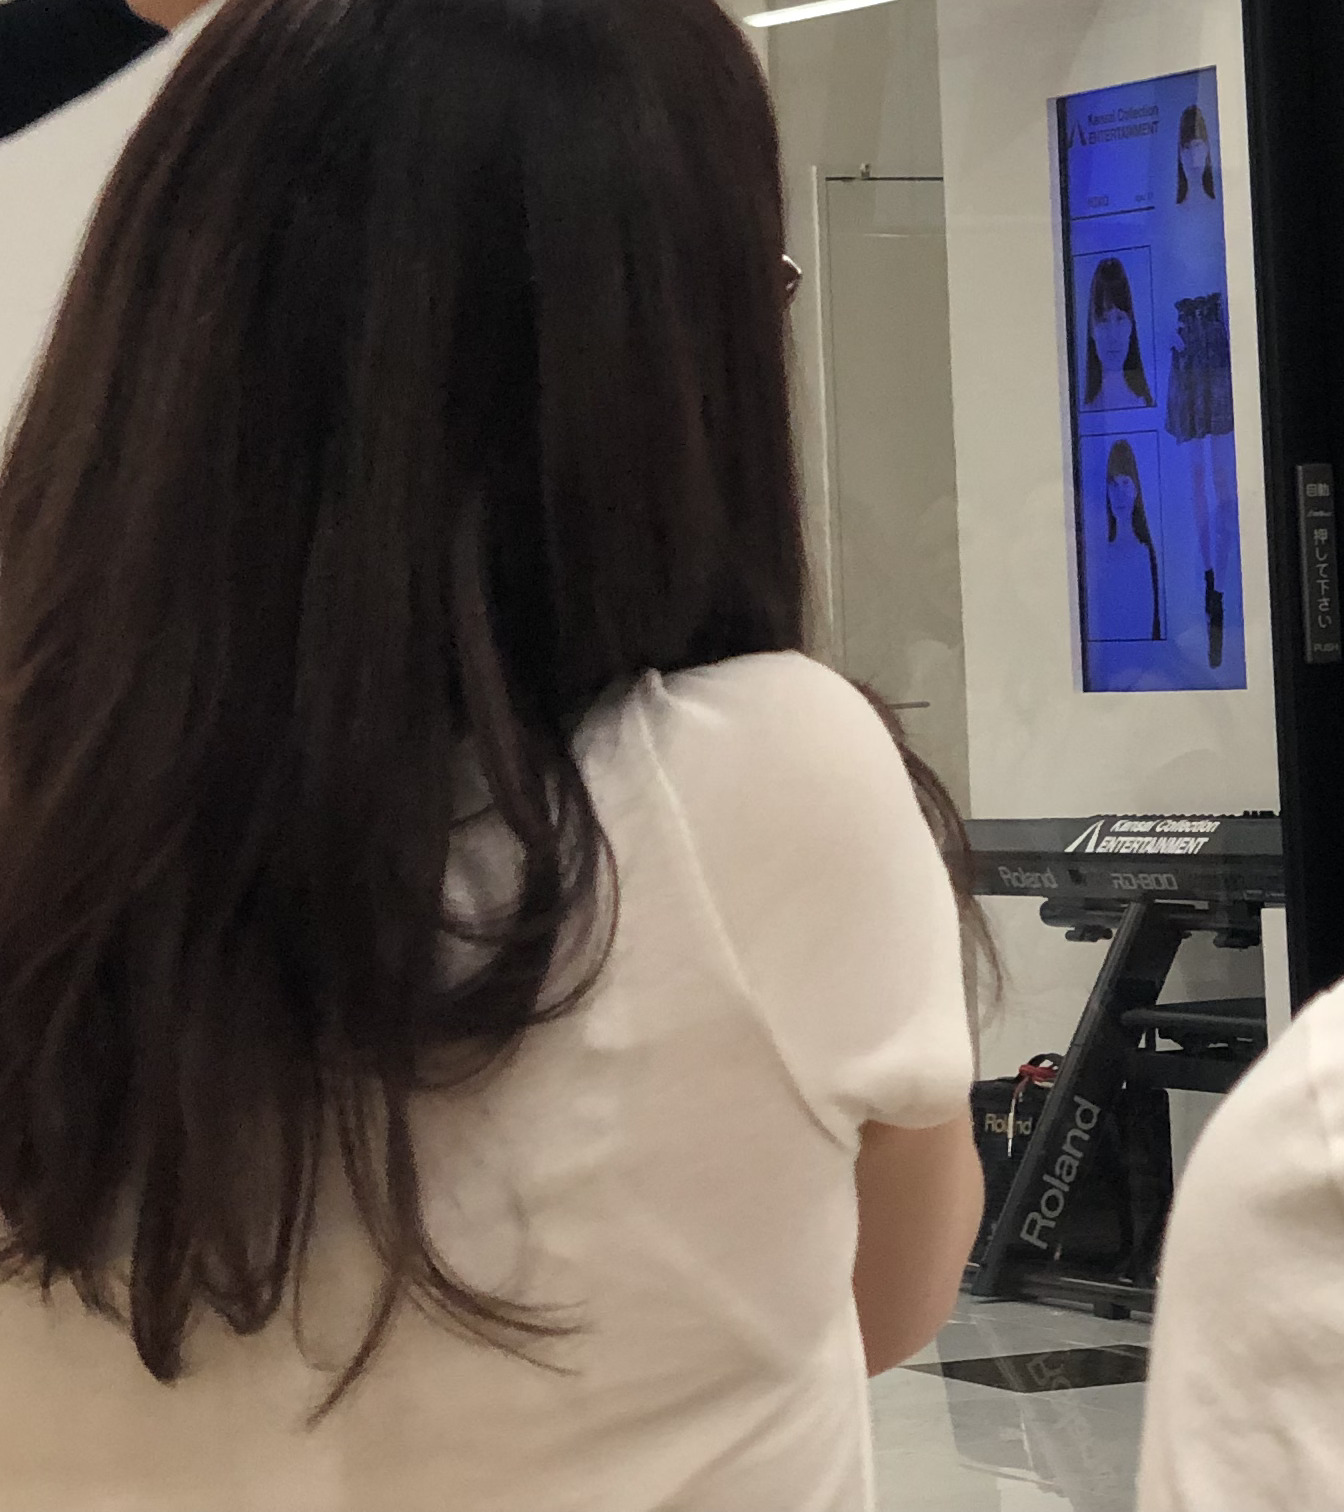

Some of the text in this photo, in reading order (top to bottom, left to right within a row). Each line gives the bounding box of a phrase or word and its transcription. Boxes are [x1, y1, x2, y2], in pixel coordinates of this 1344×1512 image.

[1312, 528, 1333, 629] 押して下さい
[1313, 642, 1339, 653] PUSH
[1109, 819, 1221, 833] Kansai Collection
[1096, 836, 1209, 855] ENTERTAINMENT
[997, 866, 1059, 890] Roland
[984, 1112, 1033, 1136] Rond
[1019, 1095, 1102, 1250] Roland
